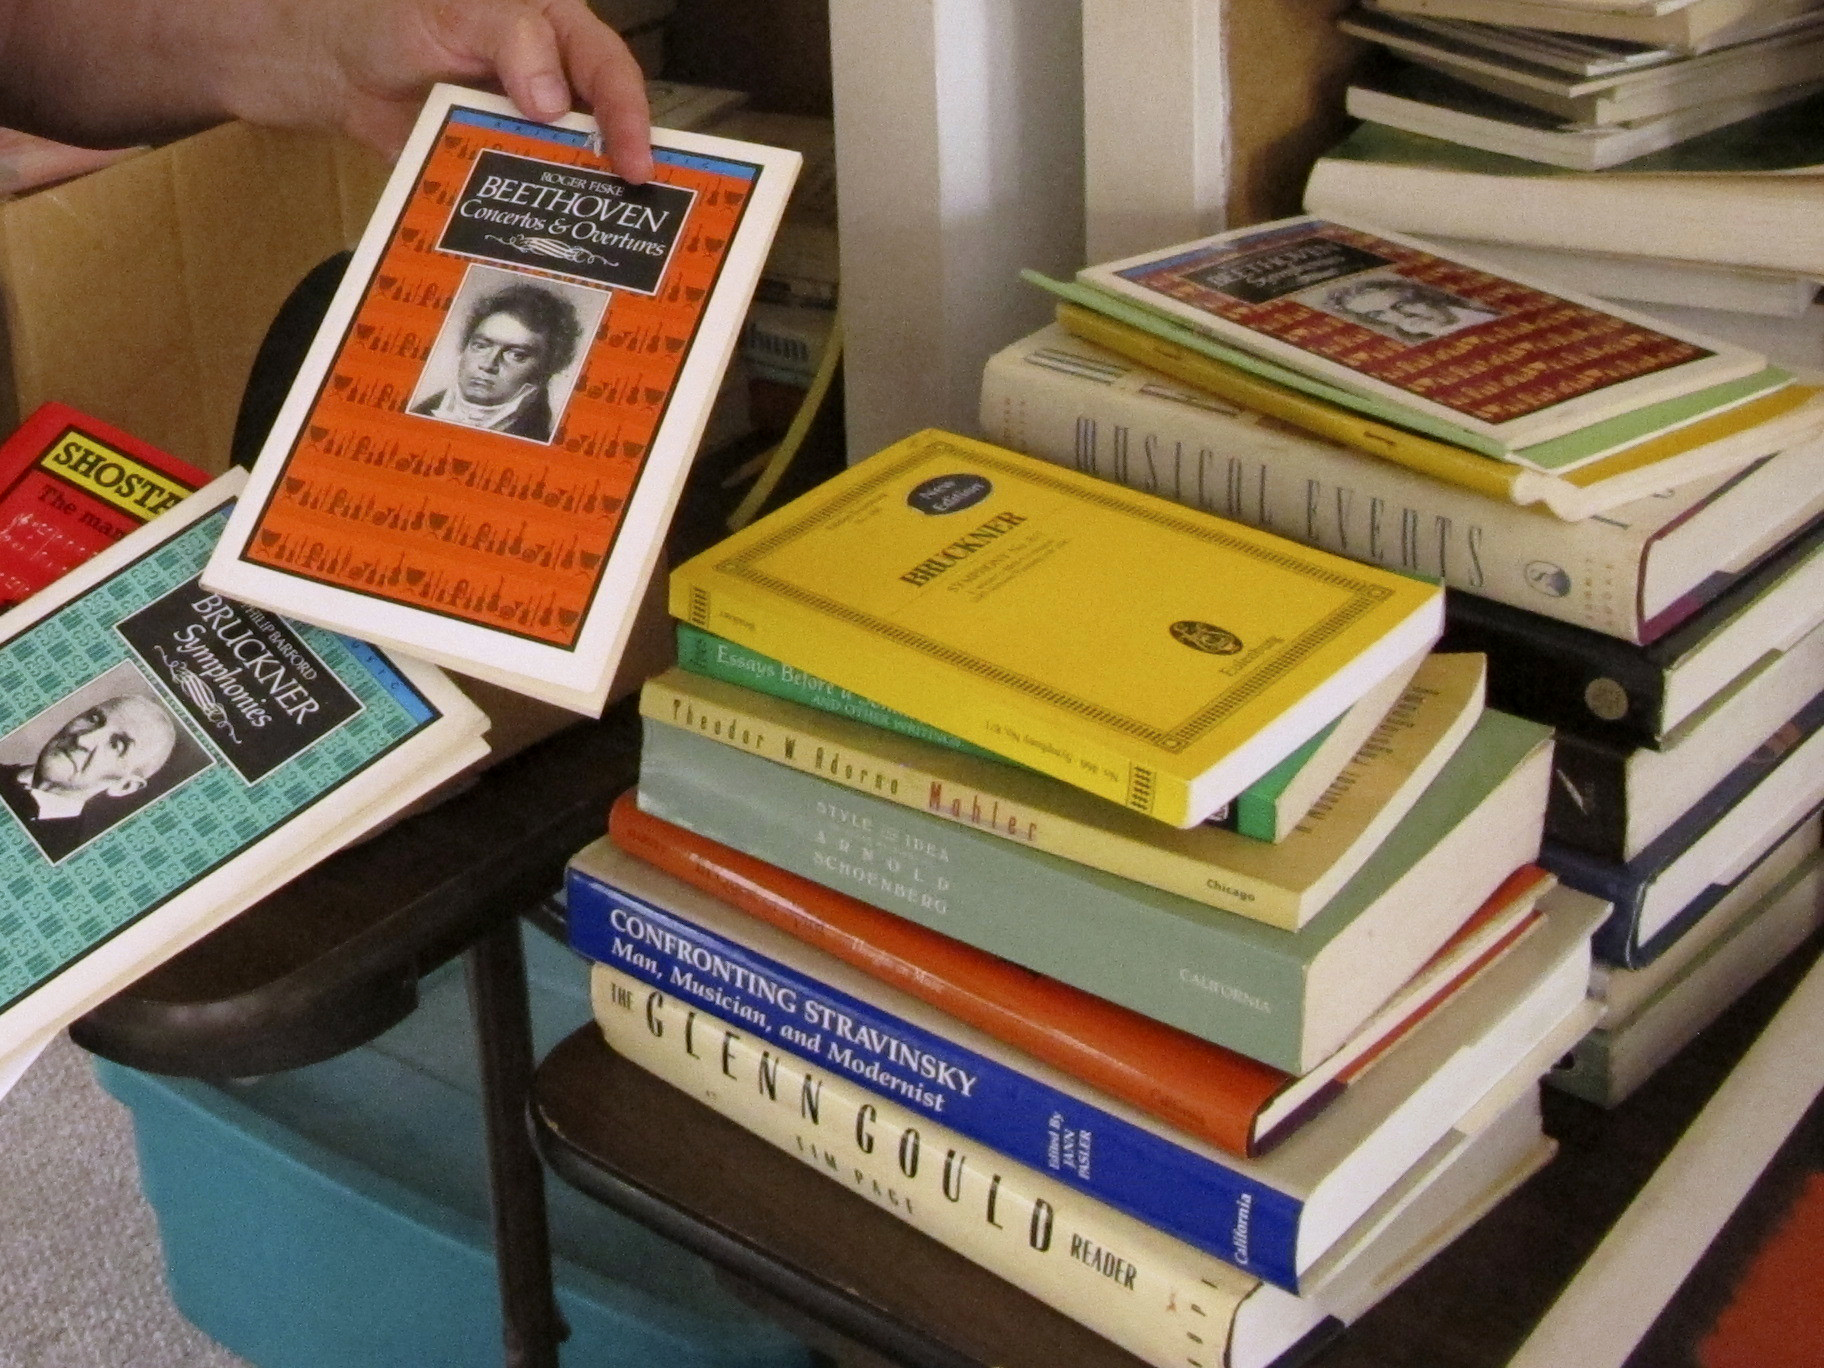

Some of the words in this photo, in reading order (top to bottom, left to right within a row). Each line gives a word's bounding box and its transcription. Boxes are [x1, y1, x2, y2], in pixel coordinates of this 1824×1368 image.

[476, 175, 670, 233] BEETHOVEN
[541, 171, 587, 191] ROGER
[587, 180, 624, 197] FISKE
[460, 199, 545, 232] Concertos
[547, 217, 571, 235] &
[571, 220, 667, 258] Overtures
[37, 484, 77, 515] The
[1306, 478, 1484, 588] EVENTS
[898, 511, 1028, 587] BRUCKNER
[173, 624, 273, 729] Symphonies
[191, 594, 320, 726] BRUCKNER
[715, 644, 776, 679] Essays
[671, 697, 765, 750] Theodor
[814, 745, 900, 795] Adorno
[928, 780, 1040, 844] Mahler
[816, 801, 874, 832] STYLE
[904, 833, 950, 863] IDEA
[813, 851, 948, 916] SCHOENBERG
[1206, 878, 1256, 902] Chicago
[610, 908, 797, 1013] CONFRONTING
[804, 998, 977, 1098] STRAVINSKY
[611, 936, 663, 980] Man,
[670, 966, 773, 1033] Musician,
[779, 1022, 822, 1053] and
[826, 1042, 945, 1113] Modernist
[610, 982, 634, 1012] THE
[645, 989, 824, 1125] GLENN
[854, 1103, 1055, 1254] GOULD
[1069, 1233, 1138, 1292] READER
[1234, 1193, 1253, 1265] California
